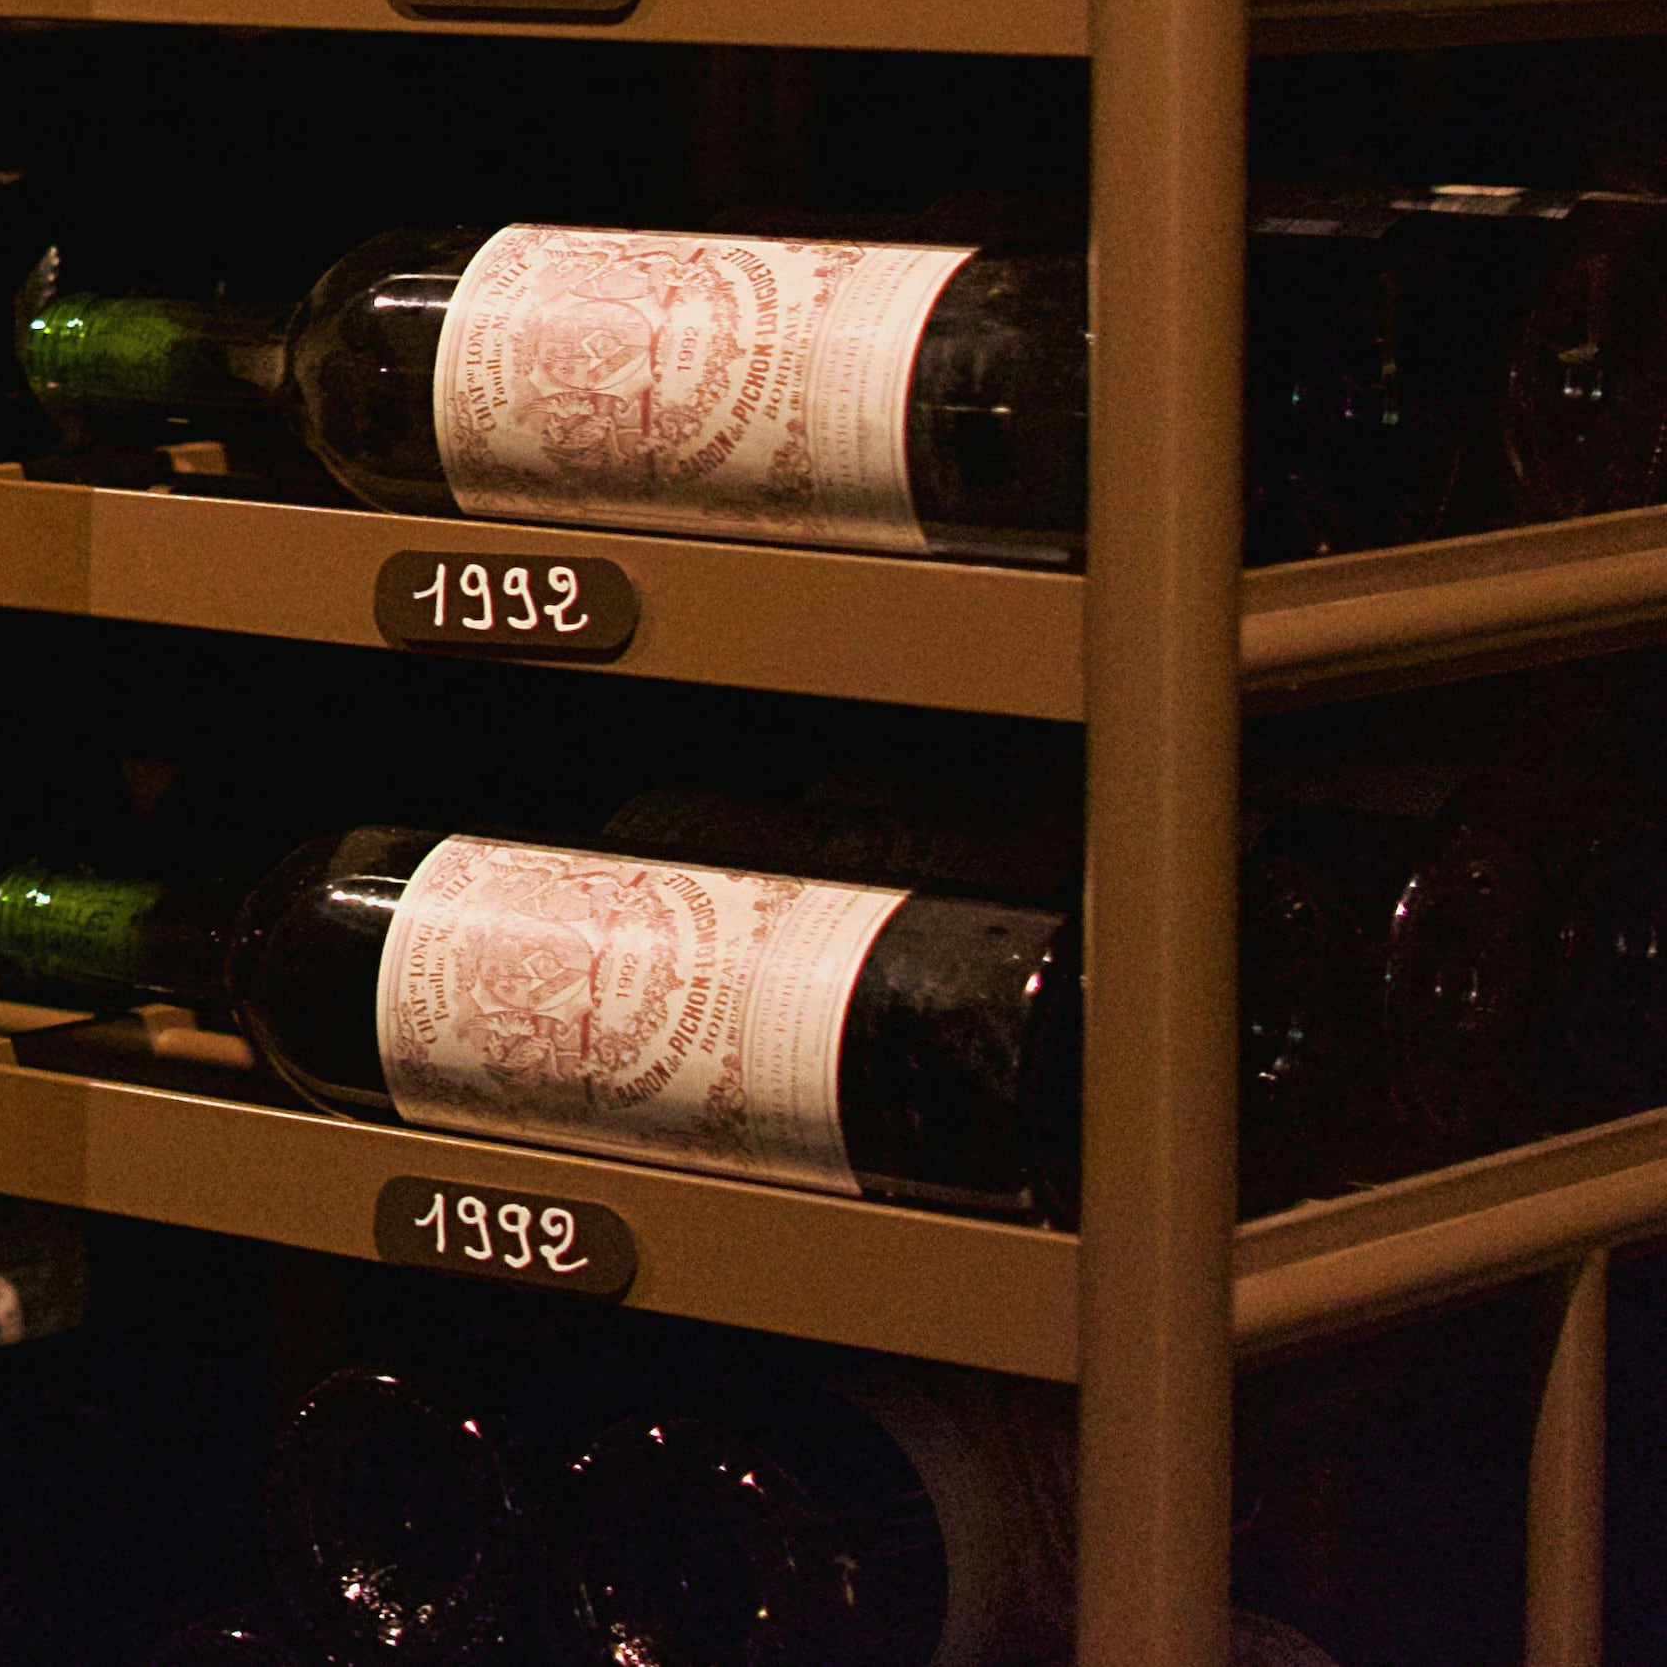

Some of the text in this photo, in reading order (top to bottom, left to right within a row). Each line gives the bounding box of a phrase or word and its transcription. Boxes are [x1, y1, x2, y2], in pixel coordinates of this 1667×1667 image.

[720, 246, 779, 337] LONGUEVILLE
[675, 325, 700, 373] 1992
[730, 342, 774, 426] PICHON
[412, 562, 590, 633] 1992
[662, 873, 719, 969] LONGUEVILLE
[614, 953, 639, 999] 1992
[667, 975, 712, 1058] PICHON
[615, 1059, 672, 1108] BARON
[413, 1192, 589, 1273] 1992
